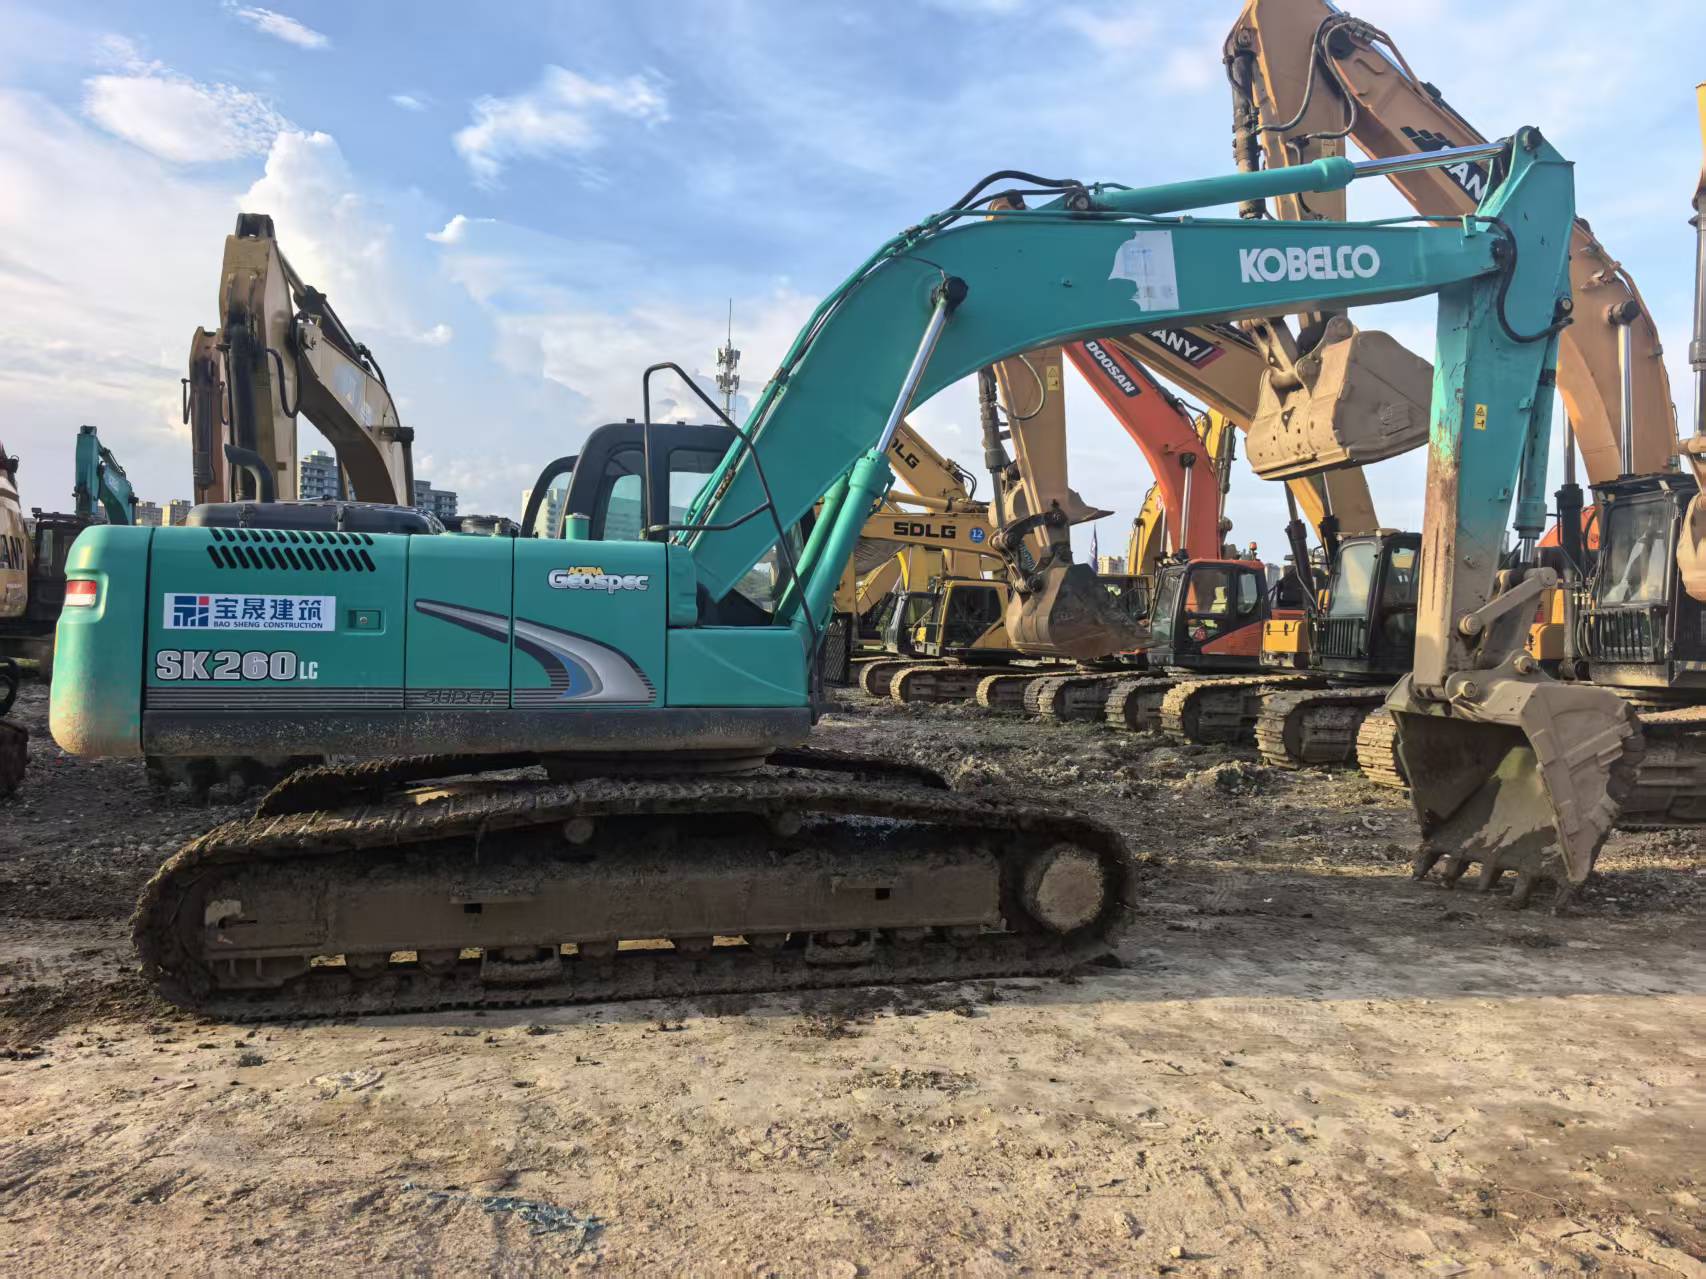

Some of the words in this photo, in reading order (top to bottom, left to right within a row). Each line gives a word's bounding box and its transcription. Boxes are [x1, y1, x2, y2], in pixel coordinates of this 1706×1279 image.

[1239, 245, 1380, 283] KOBELCO
[1085, 341, 1136, 393] DOOSAN
[894, 522, 956, 539] SDLG
[972, 529, 983, 538] 12
[548, 569, 649, 594] Geospec
[214, 597, 322, 621] 宝晟建筑
[233, 621, 260, 629] SHENG
[423, 689, 496, 705] SUPER
